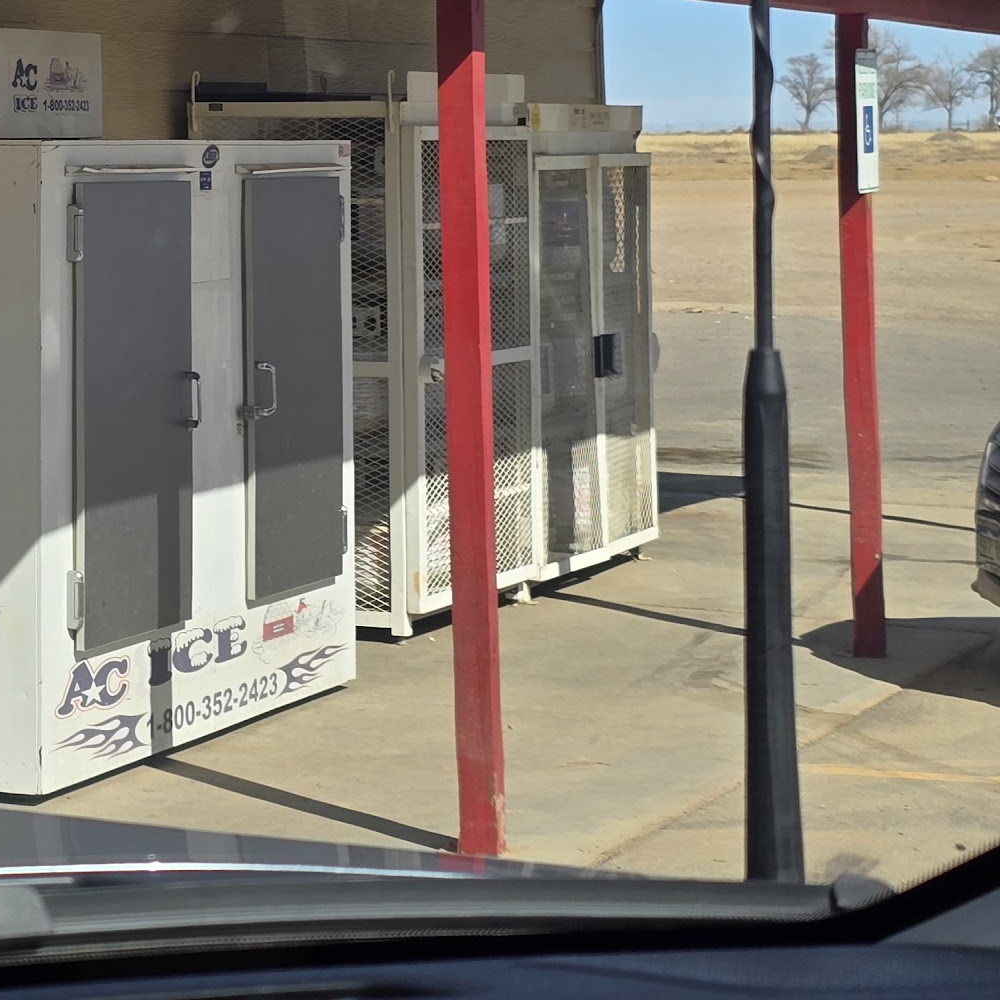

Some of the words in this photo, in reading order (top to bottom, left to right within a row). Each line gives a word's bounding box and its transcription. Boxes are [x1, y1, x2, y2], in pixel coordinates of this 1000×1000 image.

[12, 57, 38, 92] AC
[14, 96, 38, 111] ICE
[43, 99, 89, 112] 1-800-352-2423
[56, 655, 130, 719] AC
[147, 615, 248, 687] ICE
[147, 672, 278, 739] 1-800-352-2423
